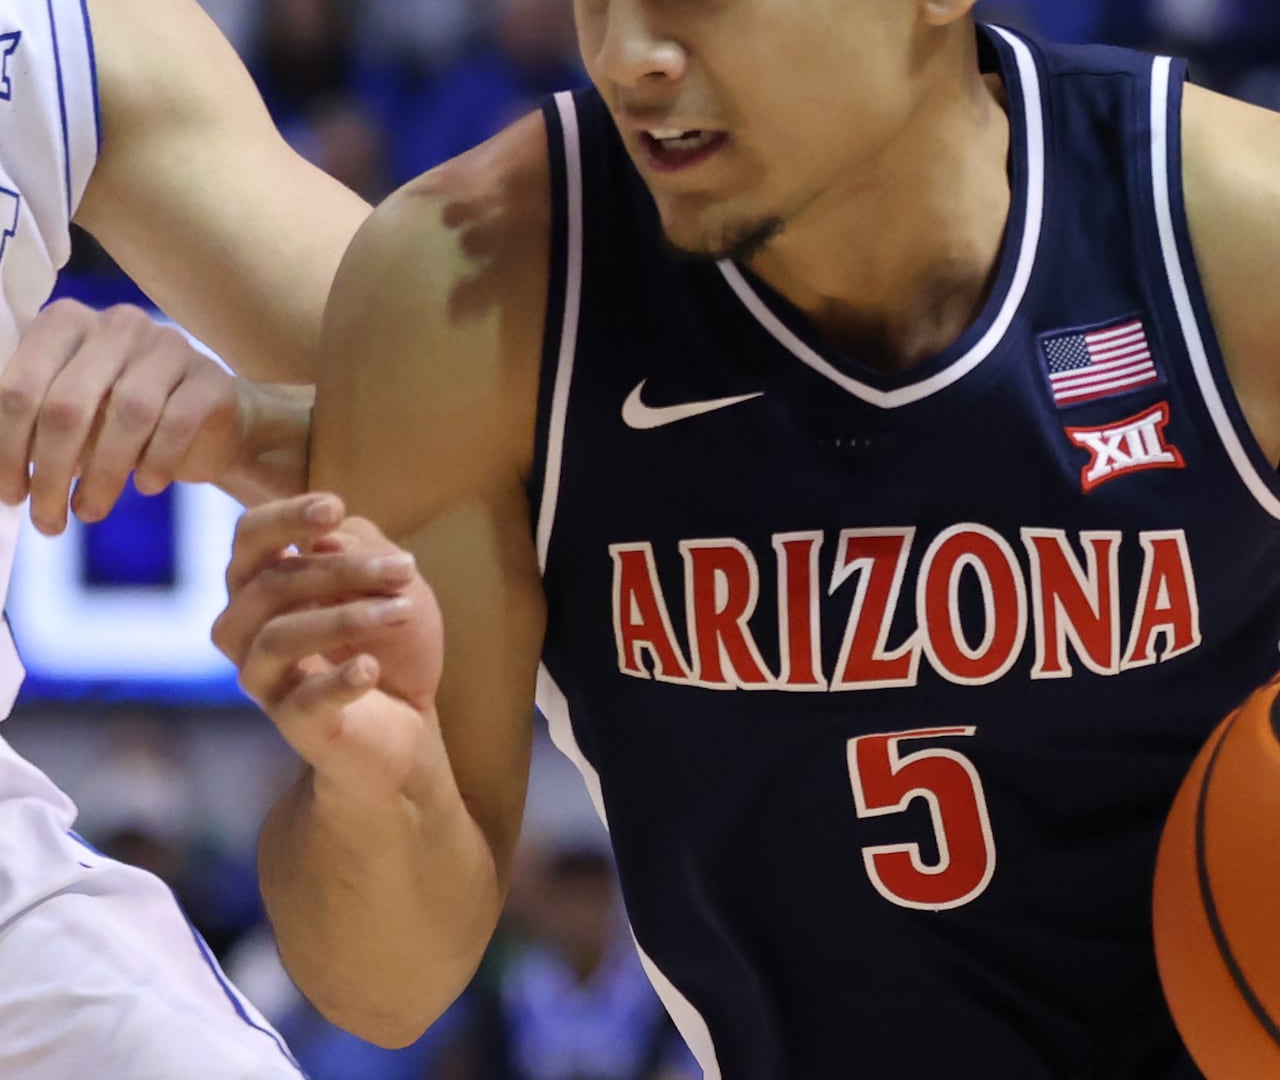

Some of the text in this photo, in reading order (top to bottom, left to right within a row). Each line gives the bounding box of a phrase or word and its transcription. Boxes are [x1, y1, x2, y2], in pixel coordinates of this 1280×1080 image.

[1069, 407, 1179, 485] XII
[608, 522, 1202, 692] ARIZONA
[846, 726, 997, 911] 5
